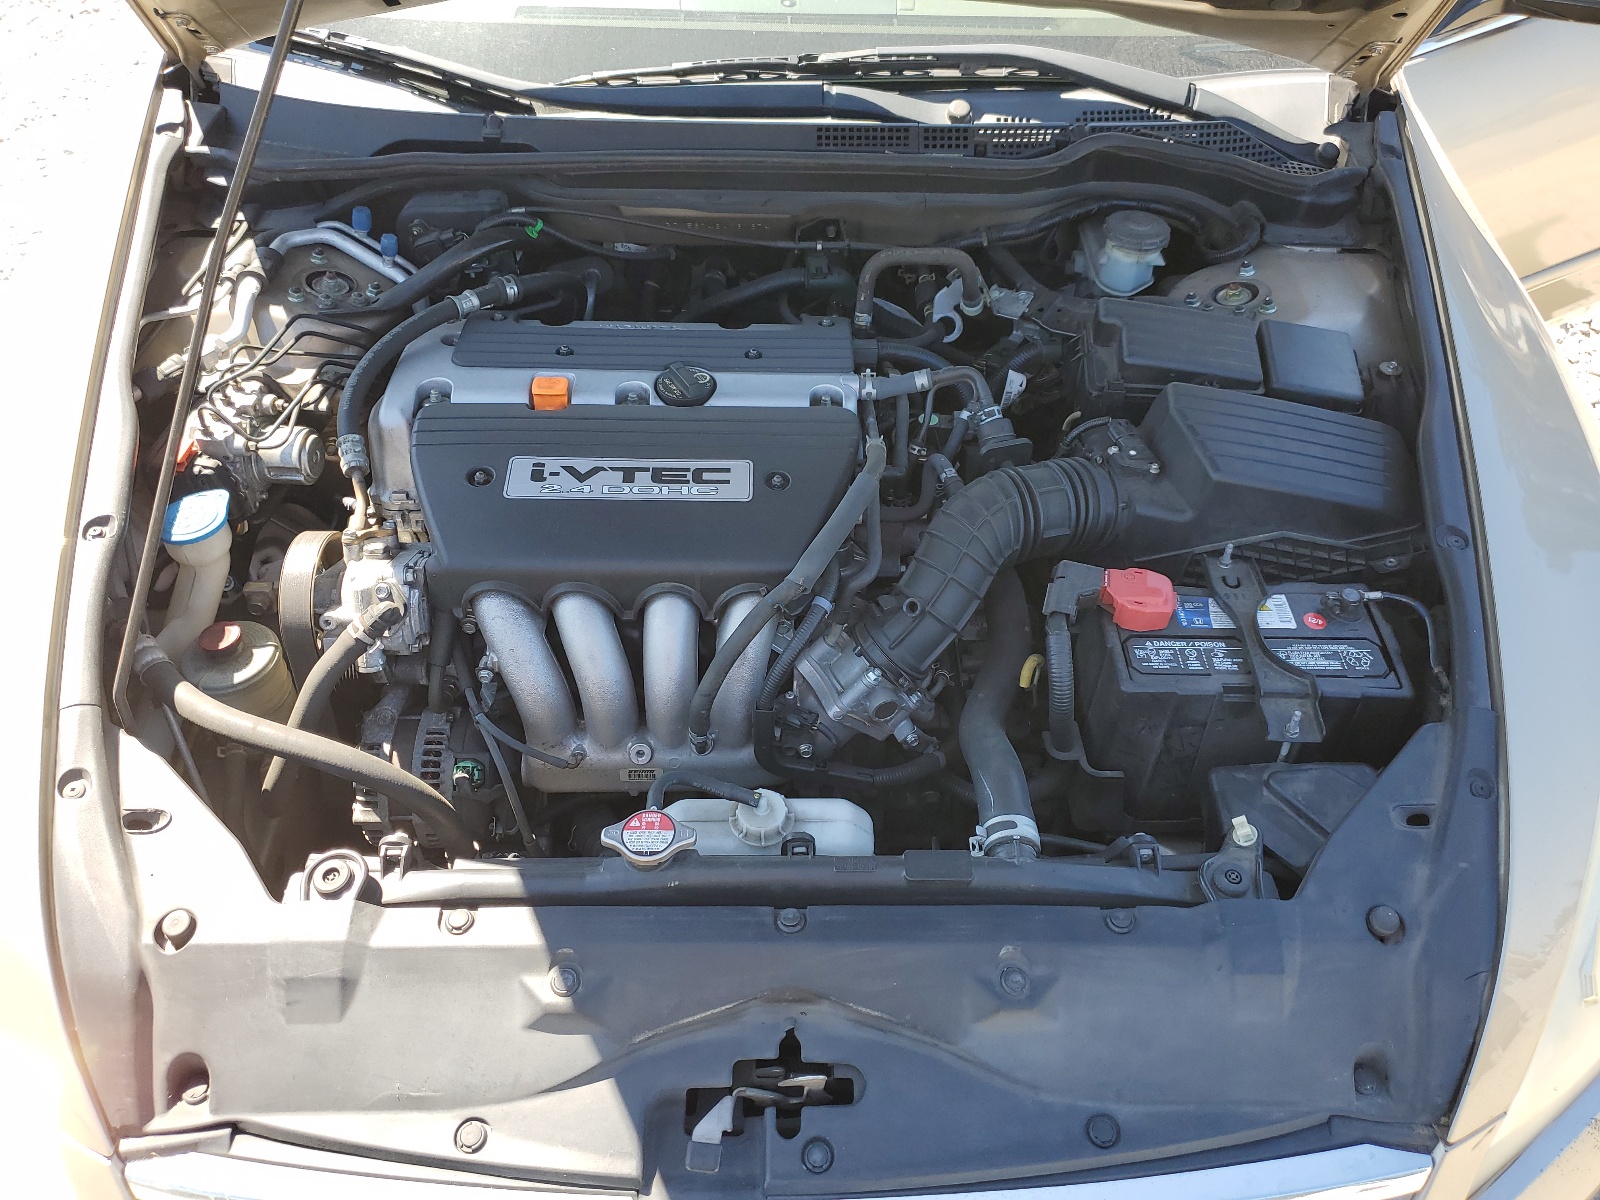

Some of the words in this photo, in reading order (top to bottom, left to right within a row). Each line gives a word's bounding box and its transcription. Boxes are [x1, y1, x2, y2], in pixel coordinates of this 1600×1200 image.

[530, 462, 731, 484] i-VTEC
[540, 485, 594, 494] 2.4
[602, 485, 719, 495] DOHC
[1308, 616, 1323, 625] 4/21
